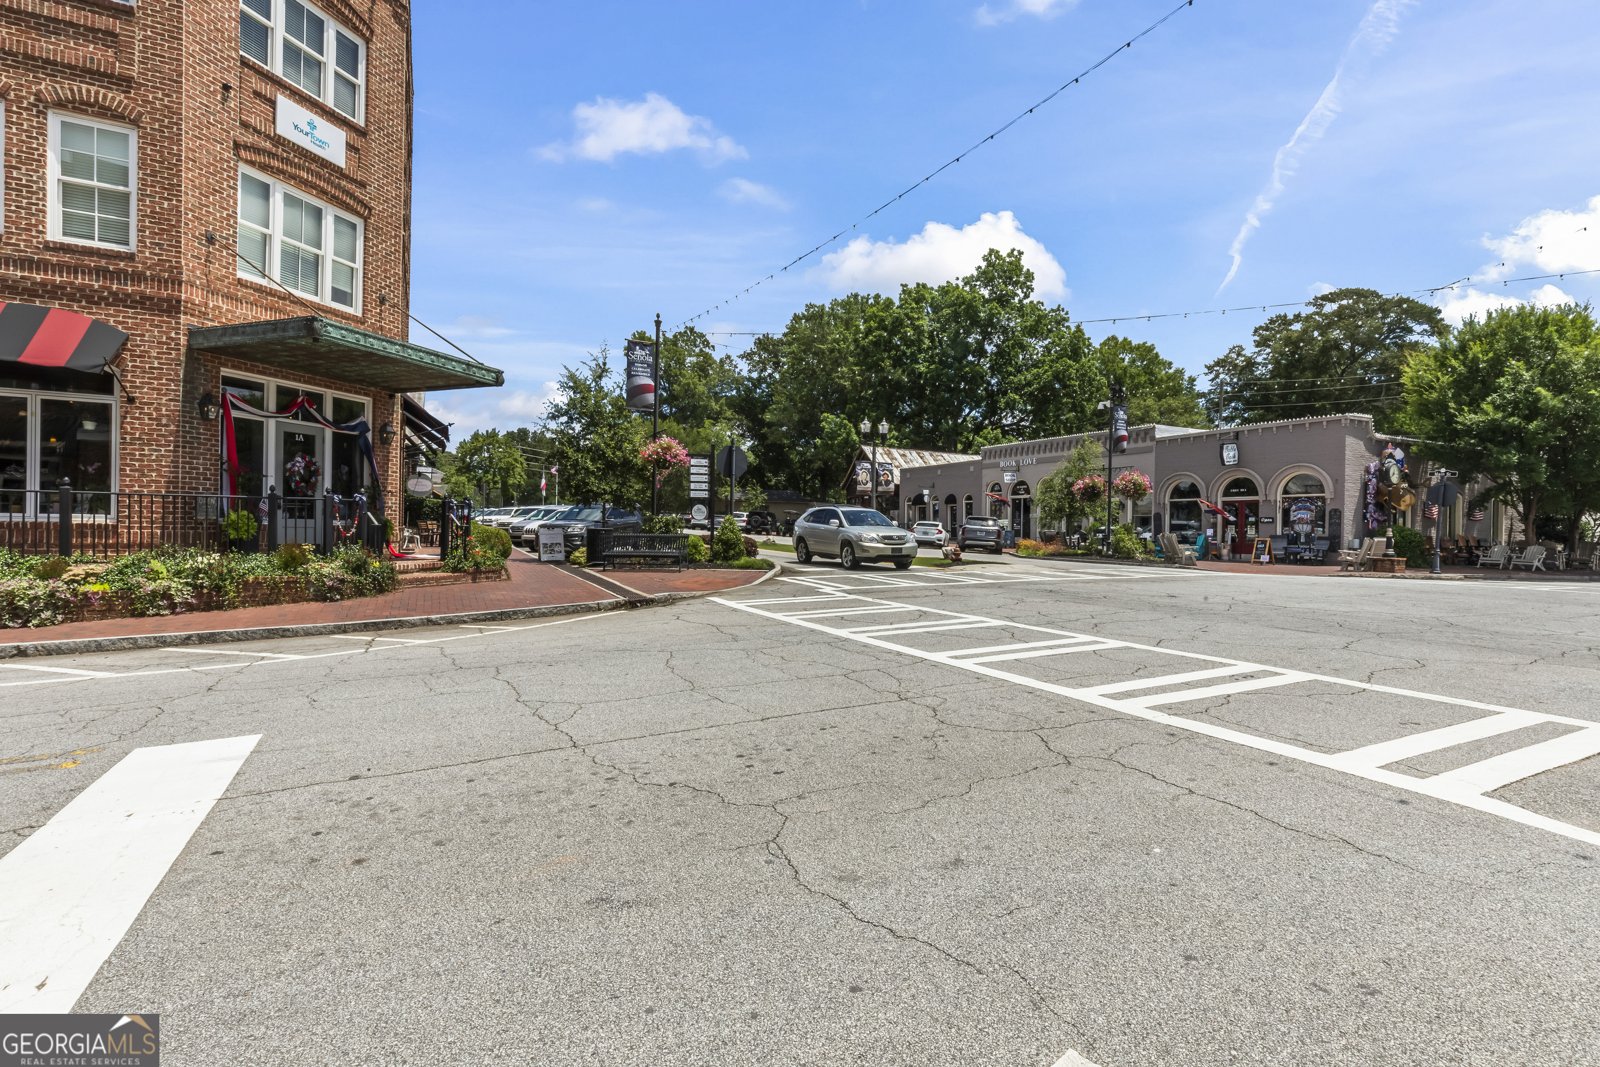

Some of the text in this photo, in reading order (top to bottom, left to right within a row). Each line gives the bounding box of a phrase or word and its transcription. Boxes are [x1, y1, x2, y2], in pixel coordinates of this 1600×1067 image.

[292, 121, 330, 148] YourTown
[1000, 457, 1037, 468] BOOK LOVE
